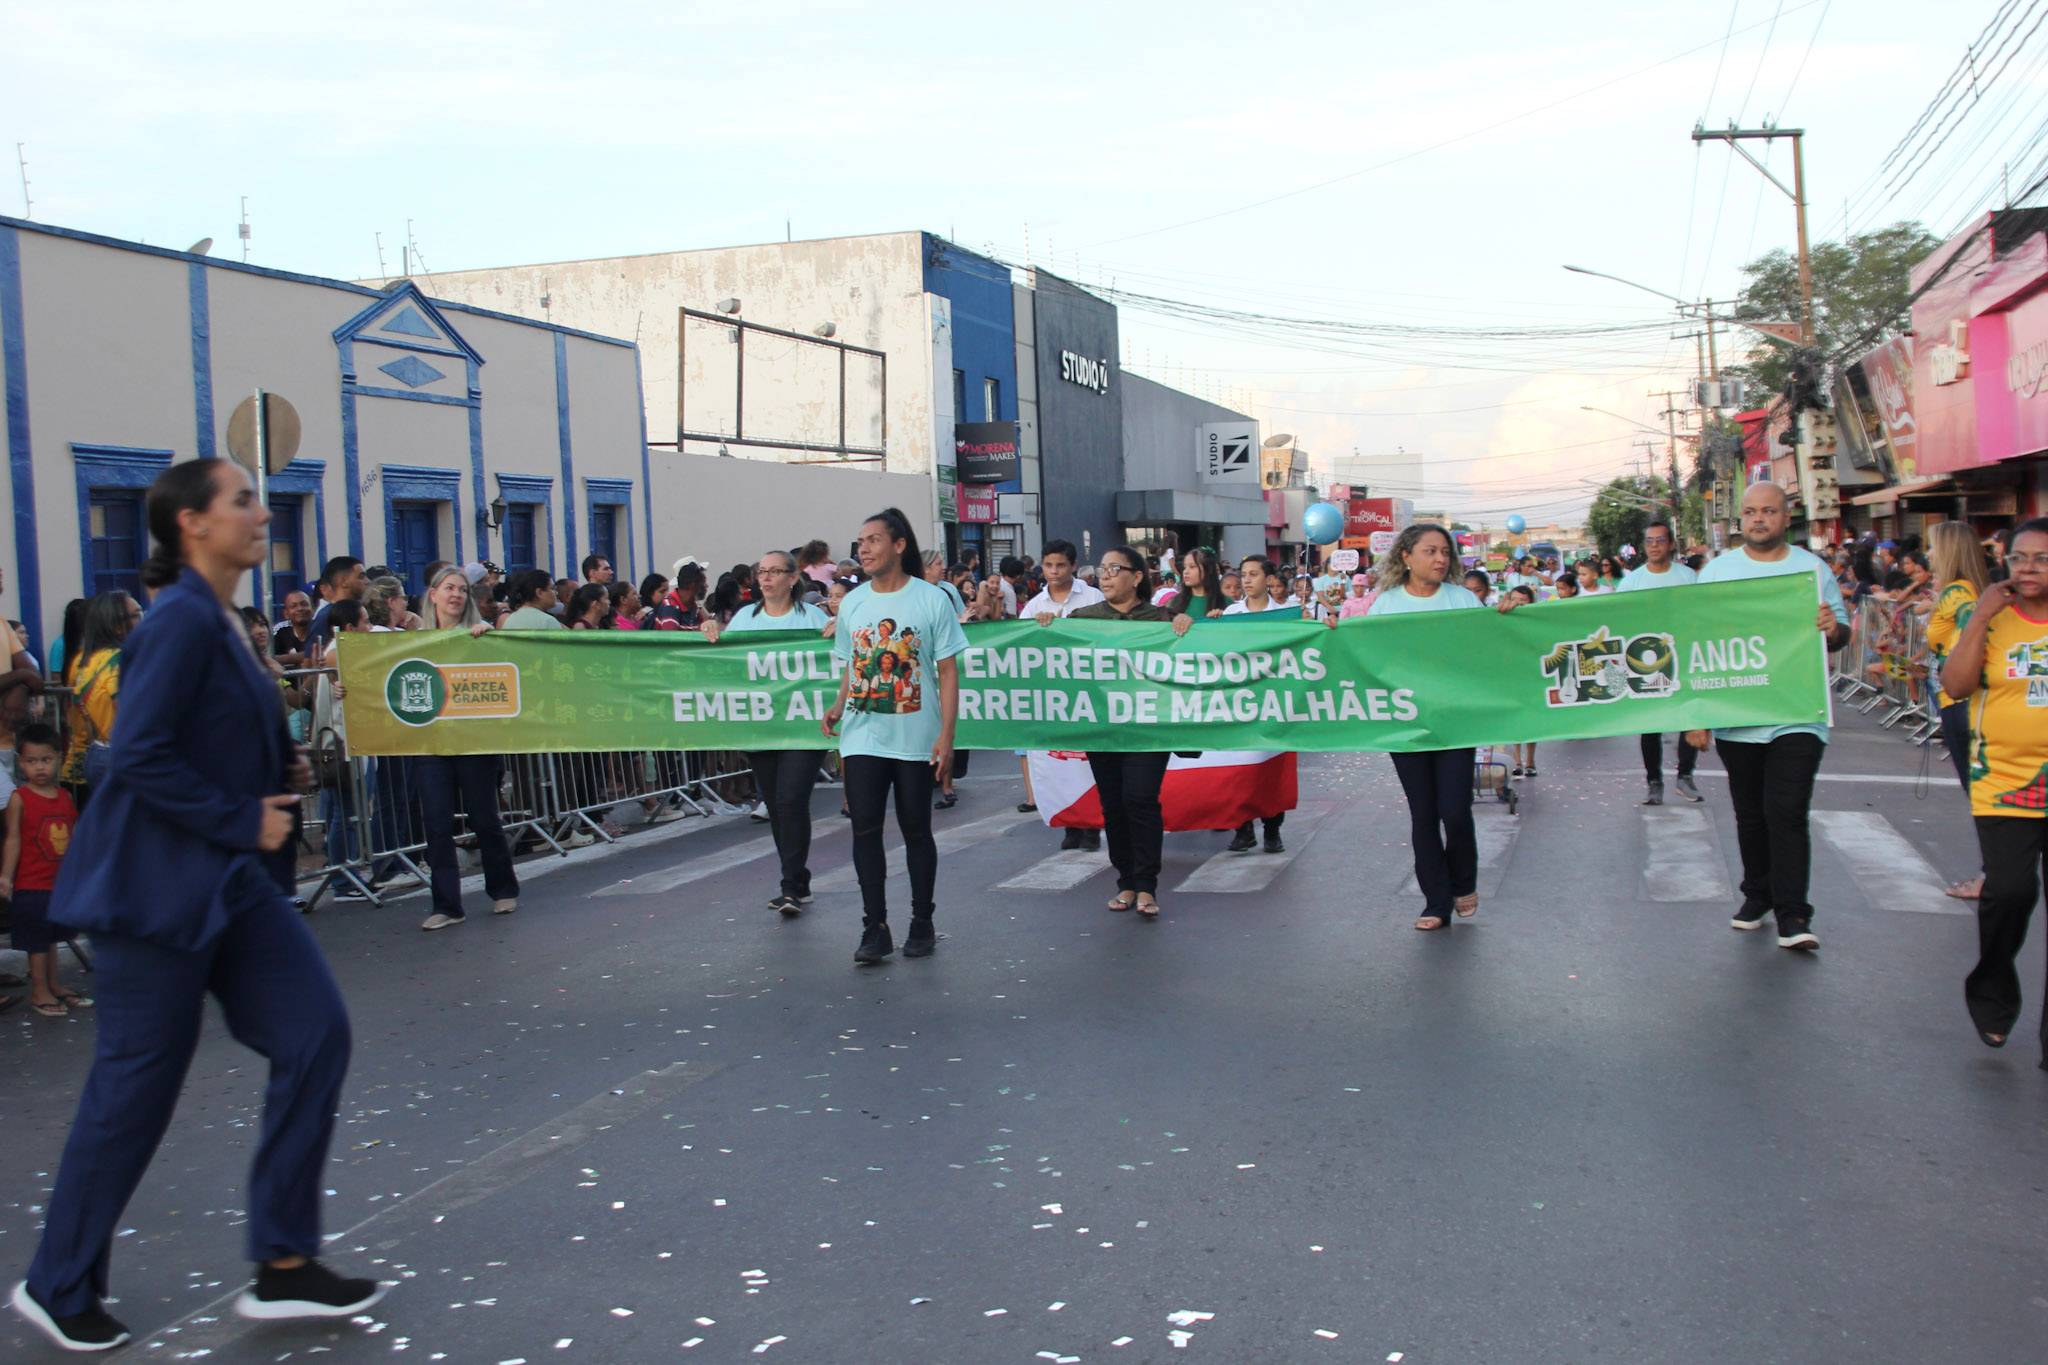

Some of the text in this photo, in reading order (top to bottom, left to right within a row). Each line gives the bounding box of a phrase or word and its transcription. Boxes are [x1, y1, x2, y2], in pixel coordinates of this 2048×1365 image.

[1062, 349, 1099, 391] STUDIO
[988, 452, 1017, 462] MAKES
[1209, 433, 1219, 476] STUDIO
[1350, 514, 1393, 524] TROPICAL
[964, 647, 1327, 684] EMPREENDEDORAS
[1688, 635, 1767, 673] ANOS
[452, 679, 507, 692] VÁRZEA
[1729, 673, 1770, 688] GRANDE
[452, 693, 509, 703] GRANDE
[672, 691, 774, 722] EMEB
[1107, 691, 1158, 723] DE
[1171, 680, 1419, 723] MAGALHÃES
